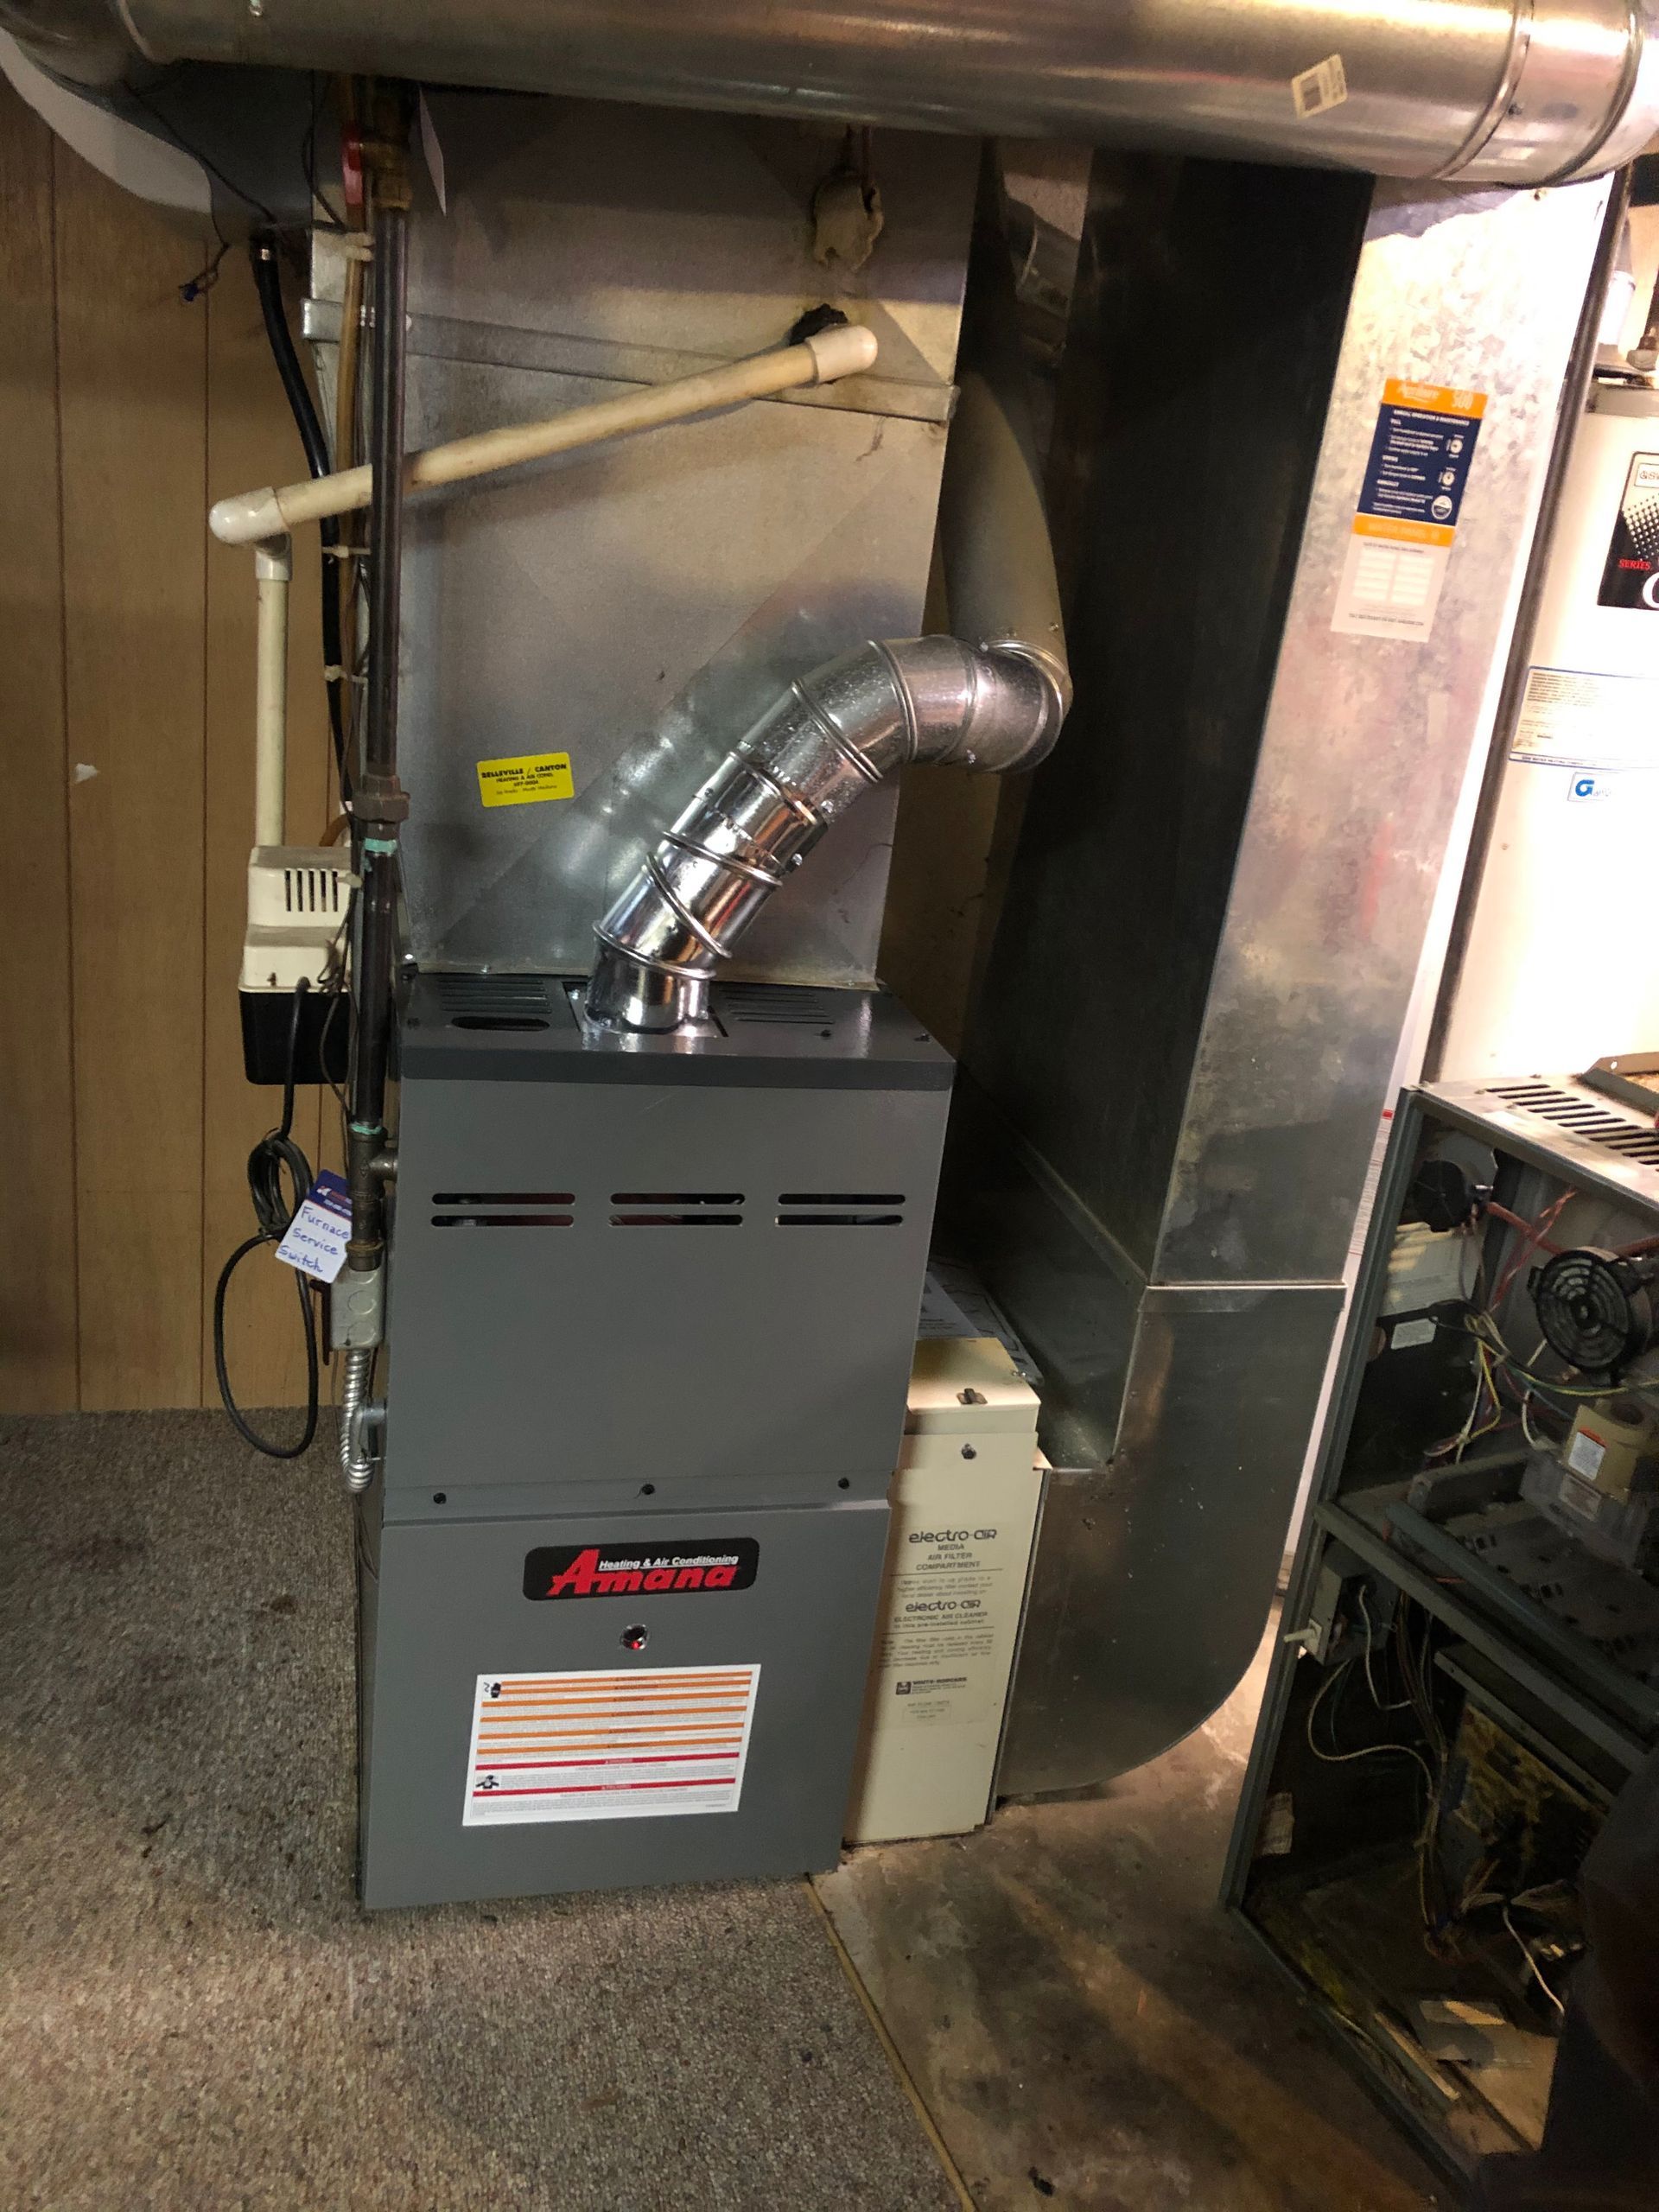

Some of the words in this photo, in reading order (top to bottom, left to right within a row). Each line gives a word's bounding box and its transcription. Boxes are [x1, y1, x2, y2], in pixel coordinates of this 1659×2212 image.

[1618, 558, 1651, 570] SERIES
[481, 768, 524, 779] BELLEVILLE
[535, 763, 567, 772] CANTON
[301, 1205, 350, 1240] Furnace
[292, 1227, 339, 1255] Service
[278, 1244, 323, 1273] Switch
[598, 1559, 640, 1571] Heating
[643, 1558, 652, 1567] &
[653, 1557, 669, 1567] Air
[671, 1554, 740, 1567] Conditioning
[916, 1561, 981, 1571] COMPARTMENT
[546, 1548, 741, 1597] Amana
[894, 1614, 939, 1623] ELECTRONIC
